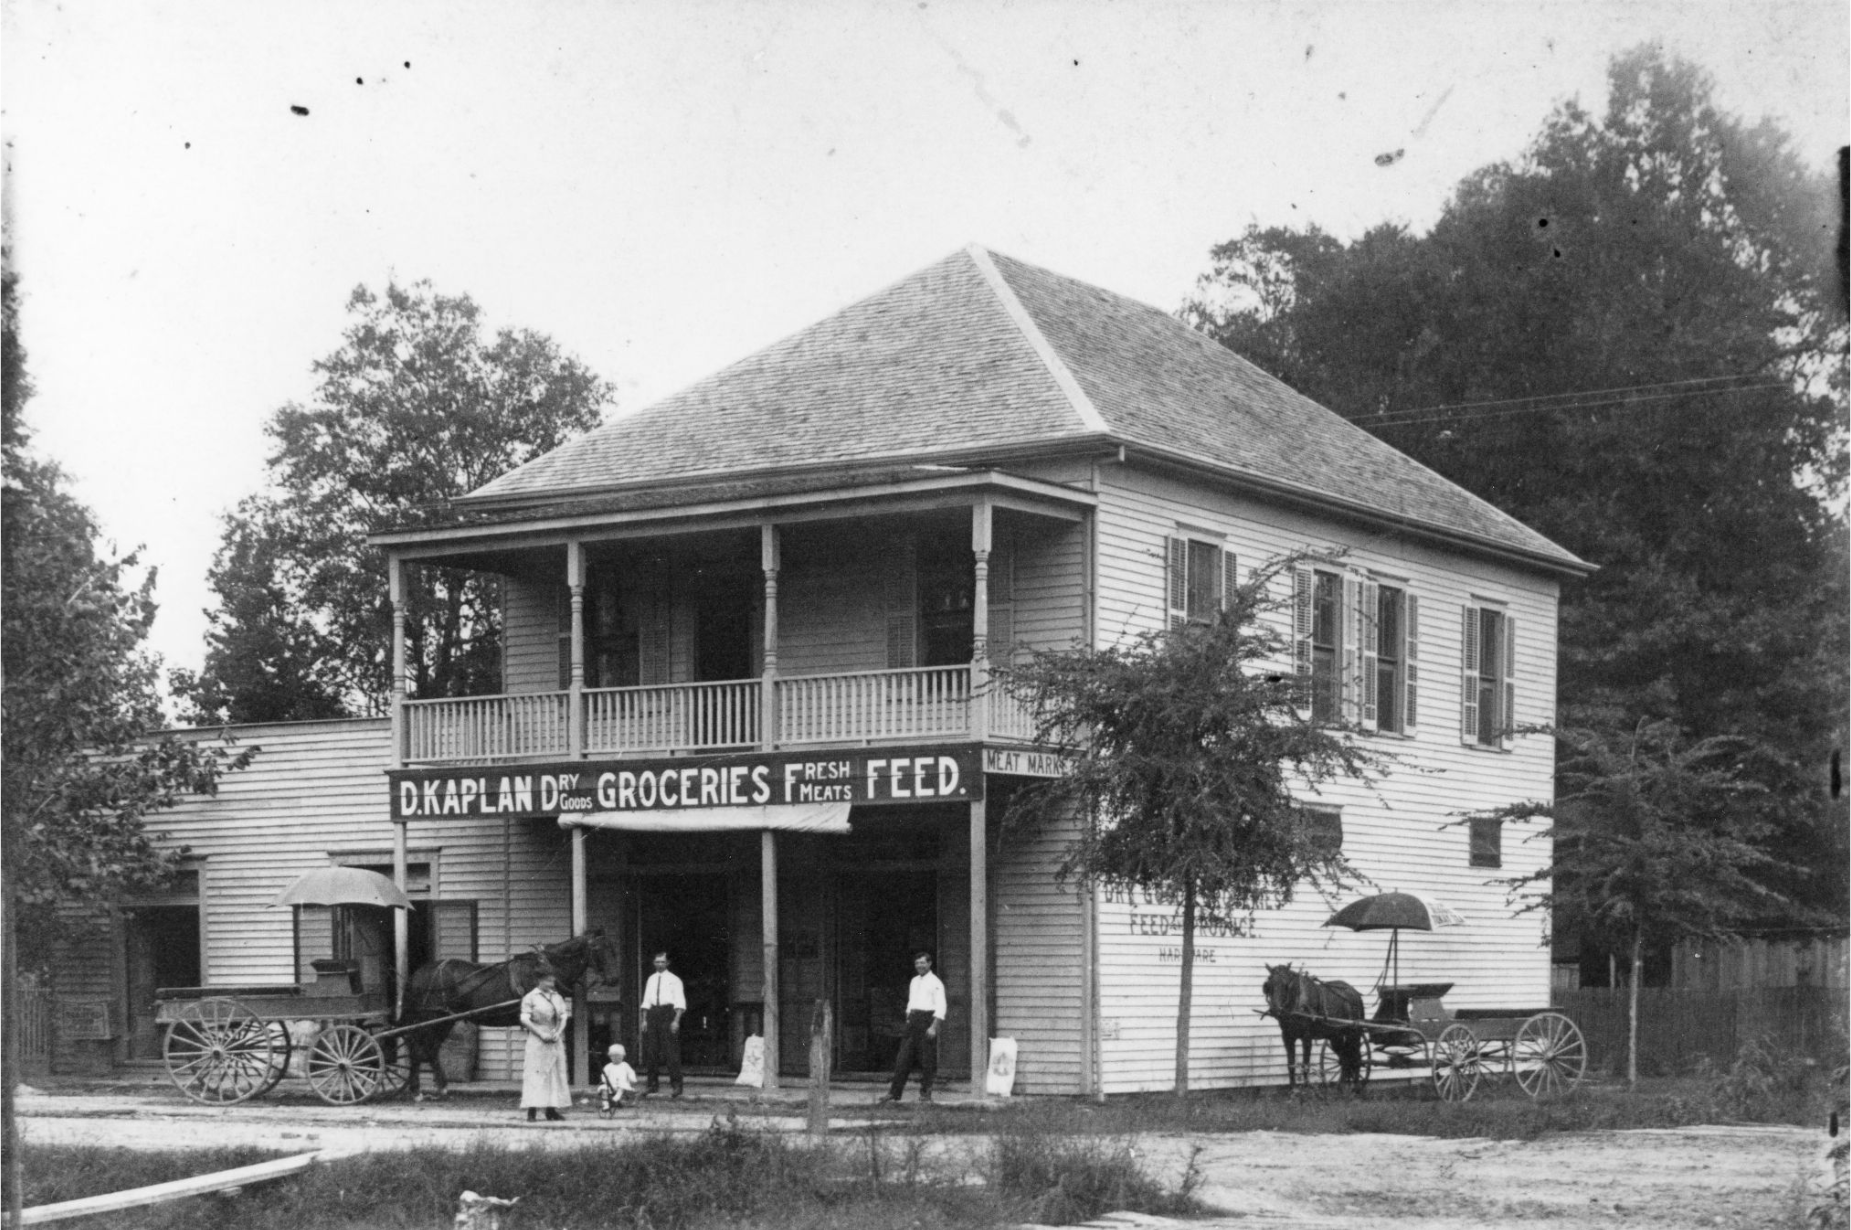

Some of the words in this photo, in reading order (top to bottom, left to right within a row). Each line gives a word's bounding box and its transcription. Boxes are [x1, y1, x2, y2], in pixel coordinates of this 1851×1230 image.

[986, 750, 1020, 772] MEAT
[1027, 753, 1066, 776] MARK
[597, 764, 770, 809] GROCERIES
[784, 760, 850, 802] FRESH
[866, 756, 967, 799] FEED.
[541, 774, 580, 811] DRY
[560, 793, 593, 810] GOODS
[800, 783, 852, 802] MEATS
[1130, 914, 1169, 936] FEED
[1159, 948, 1216, 963] HARARE
